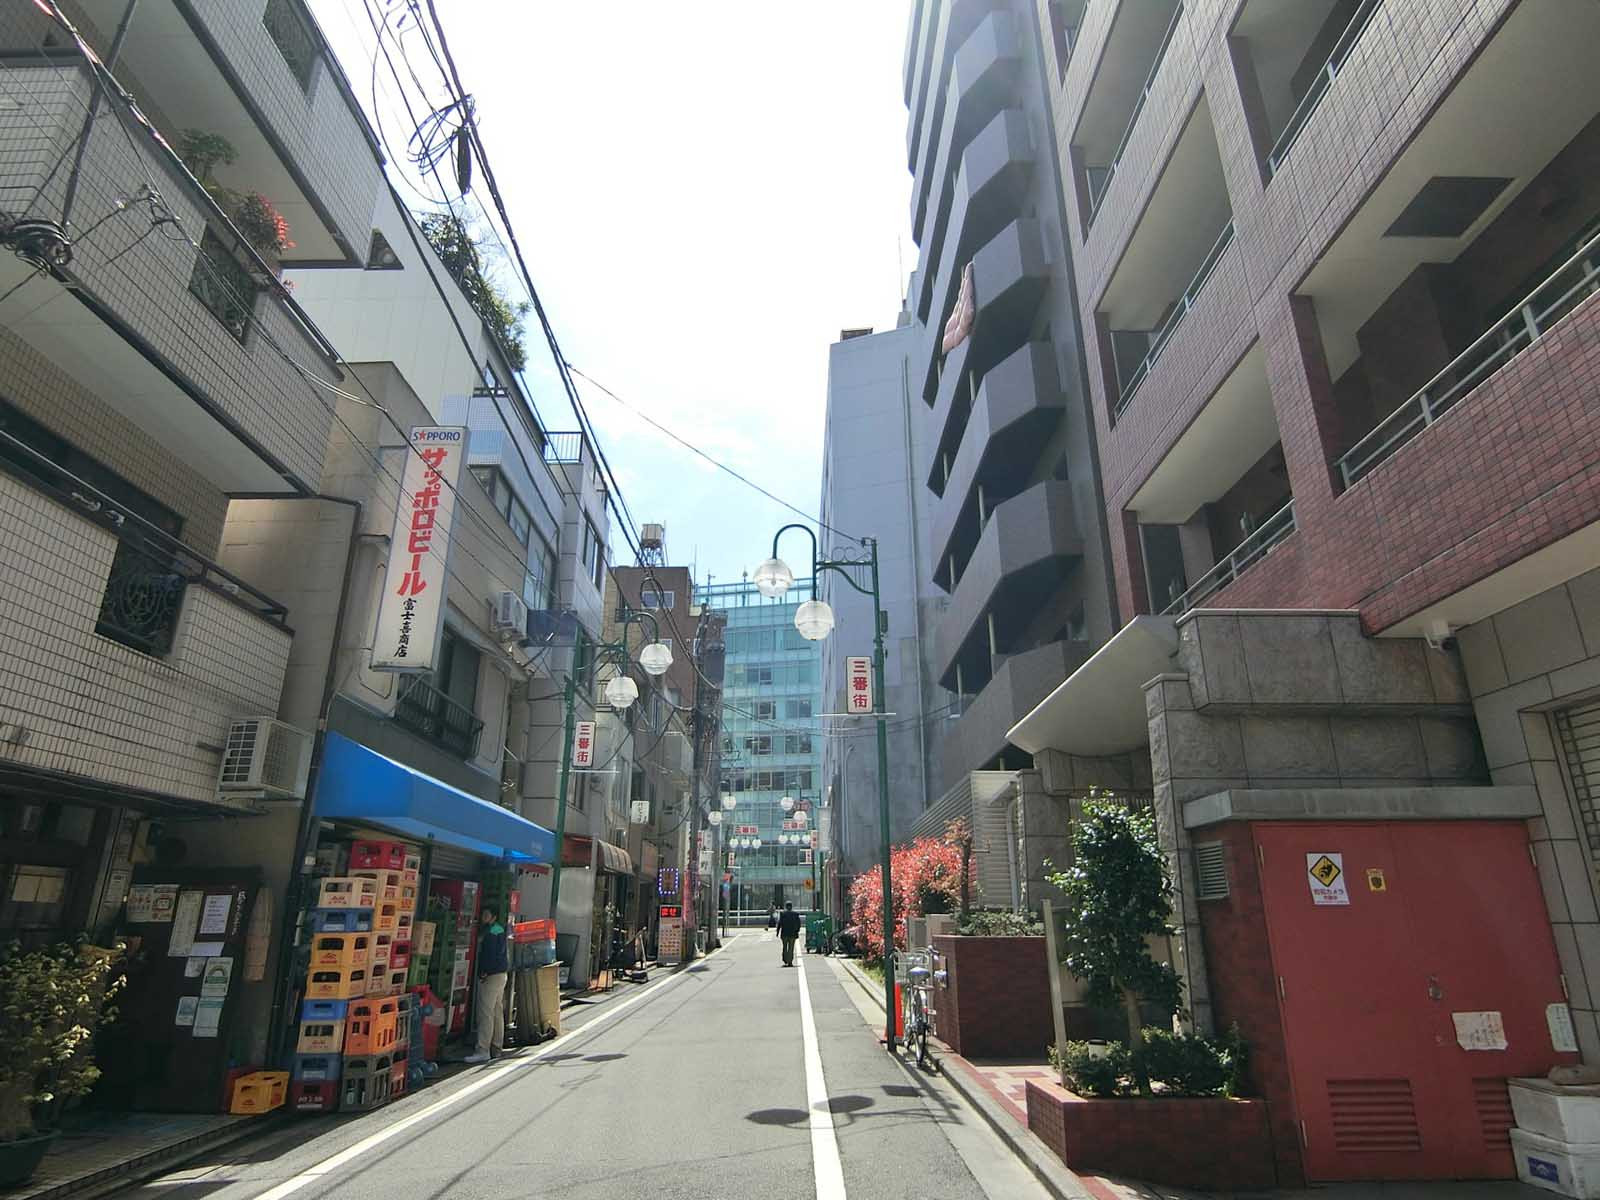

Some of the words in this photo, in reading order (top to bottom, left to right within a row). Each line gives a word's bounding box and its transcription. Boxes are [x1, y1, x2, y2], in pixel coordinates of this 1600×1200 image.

[397, 447, 448, 597] サッポロビール
[852, 660, 868, 708] 三番街
[576, 724, 590, 763] 三番街
